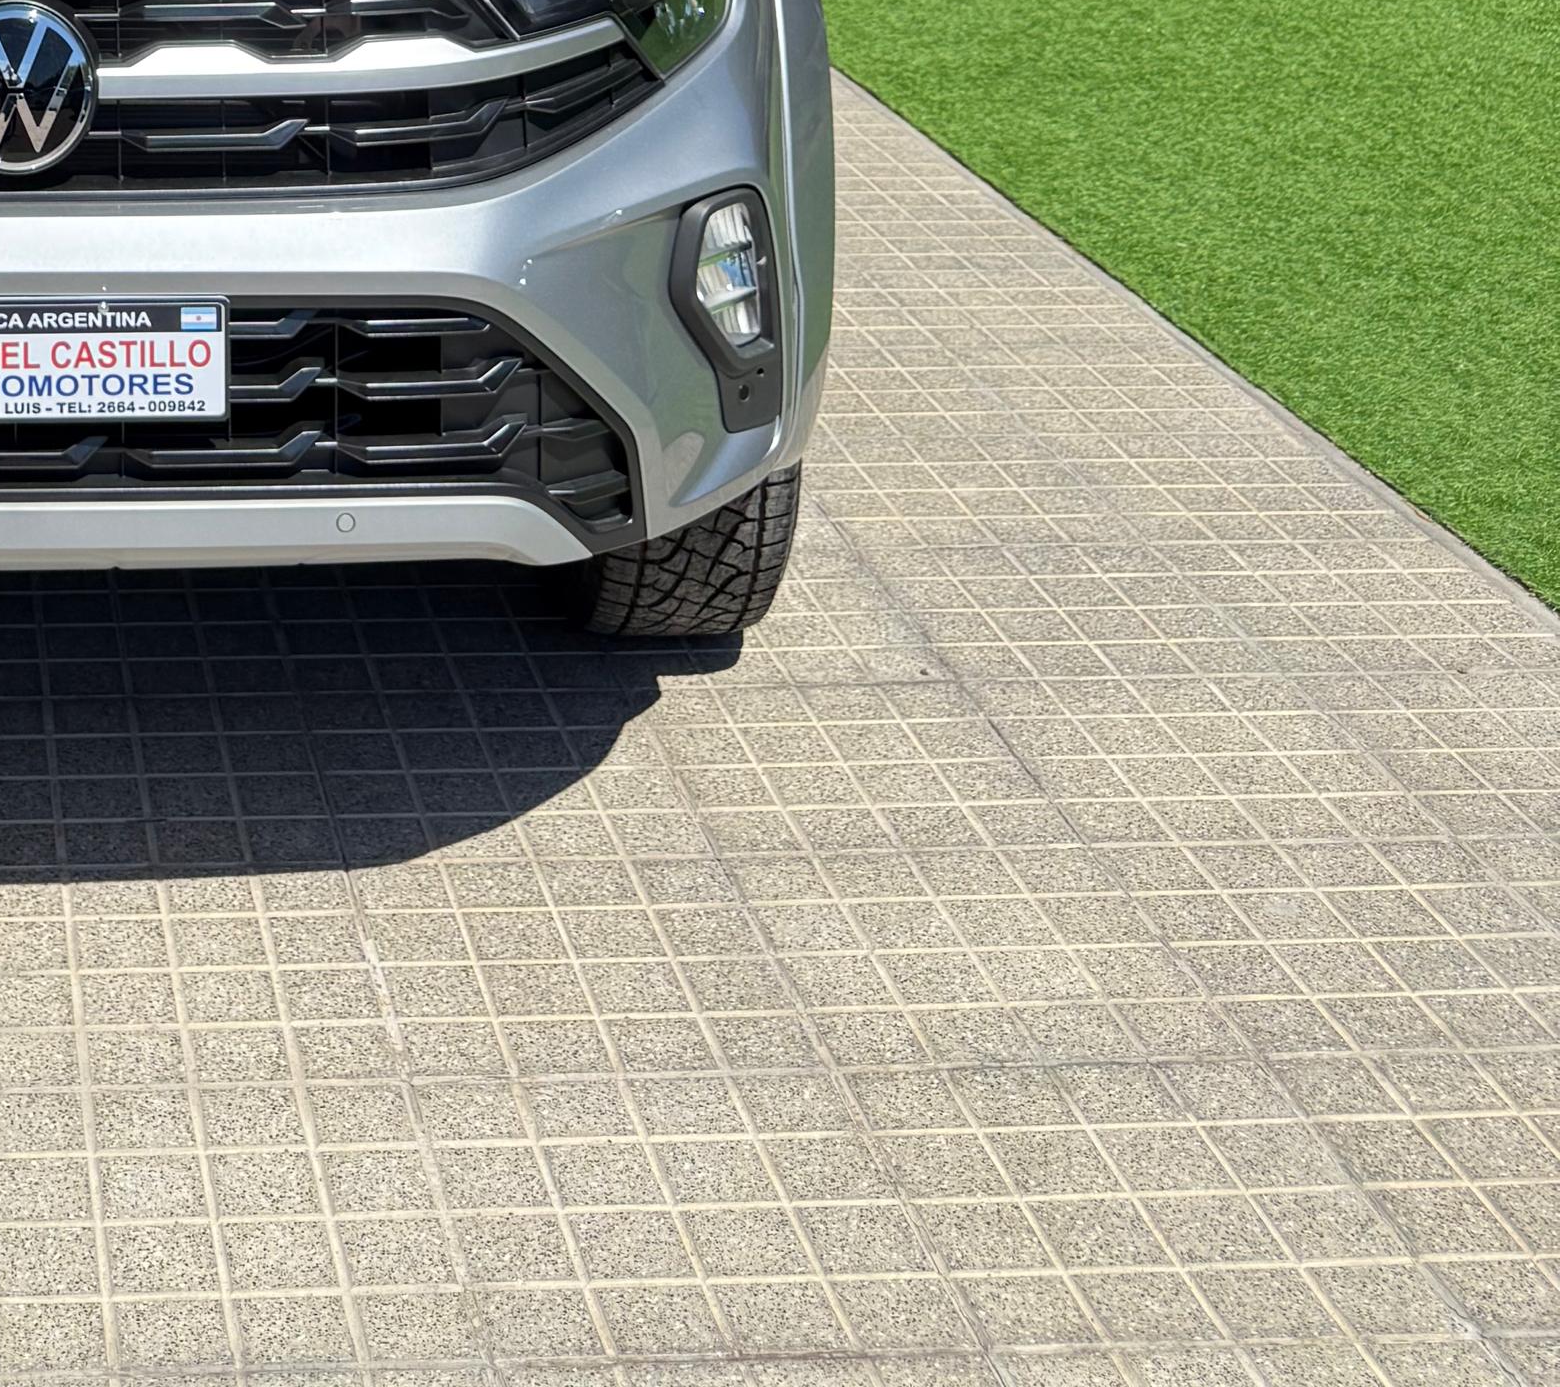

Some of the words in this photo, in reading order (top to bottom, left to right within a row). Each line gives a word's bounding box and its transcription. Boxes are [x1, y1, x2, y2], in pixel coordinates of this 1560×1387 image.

[27, 311, 152, 328] ARGENTINA
[50, 339, 211, 369] CASTILLO
[5, 402, 41, 414] LUIS
[56, 402, 92, 413] TEL:
